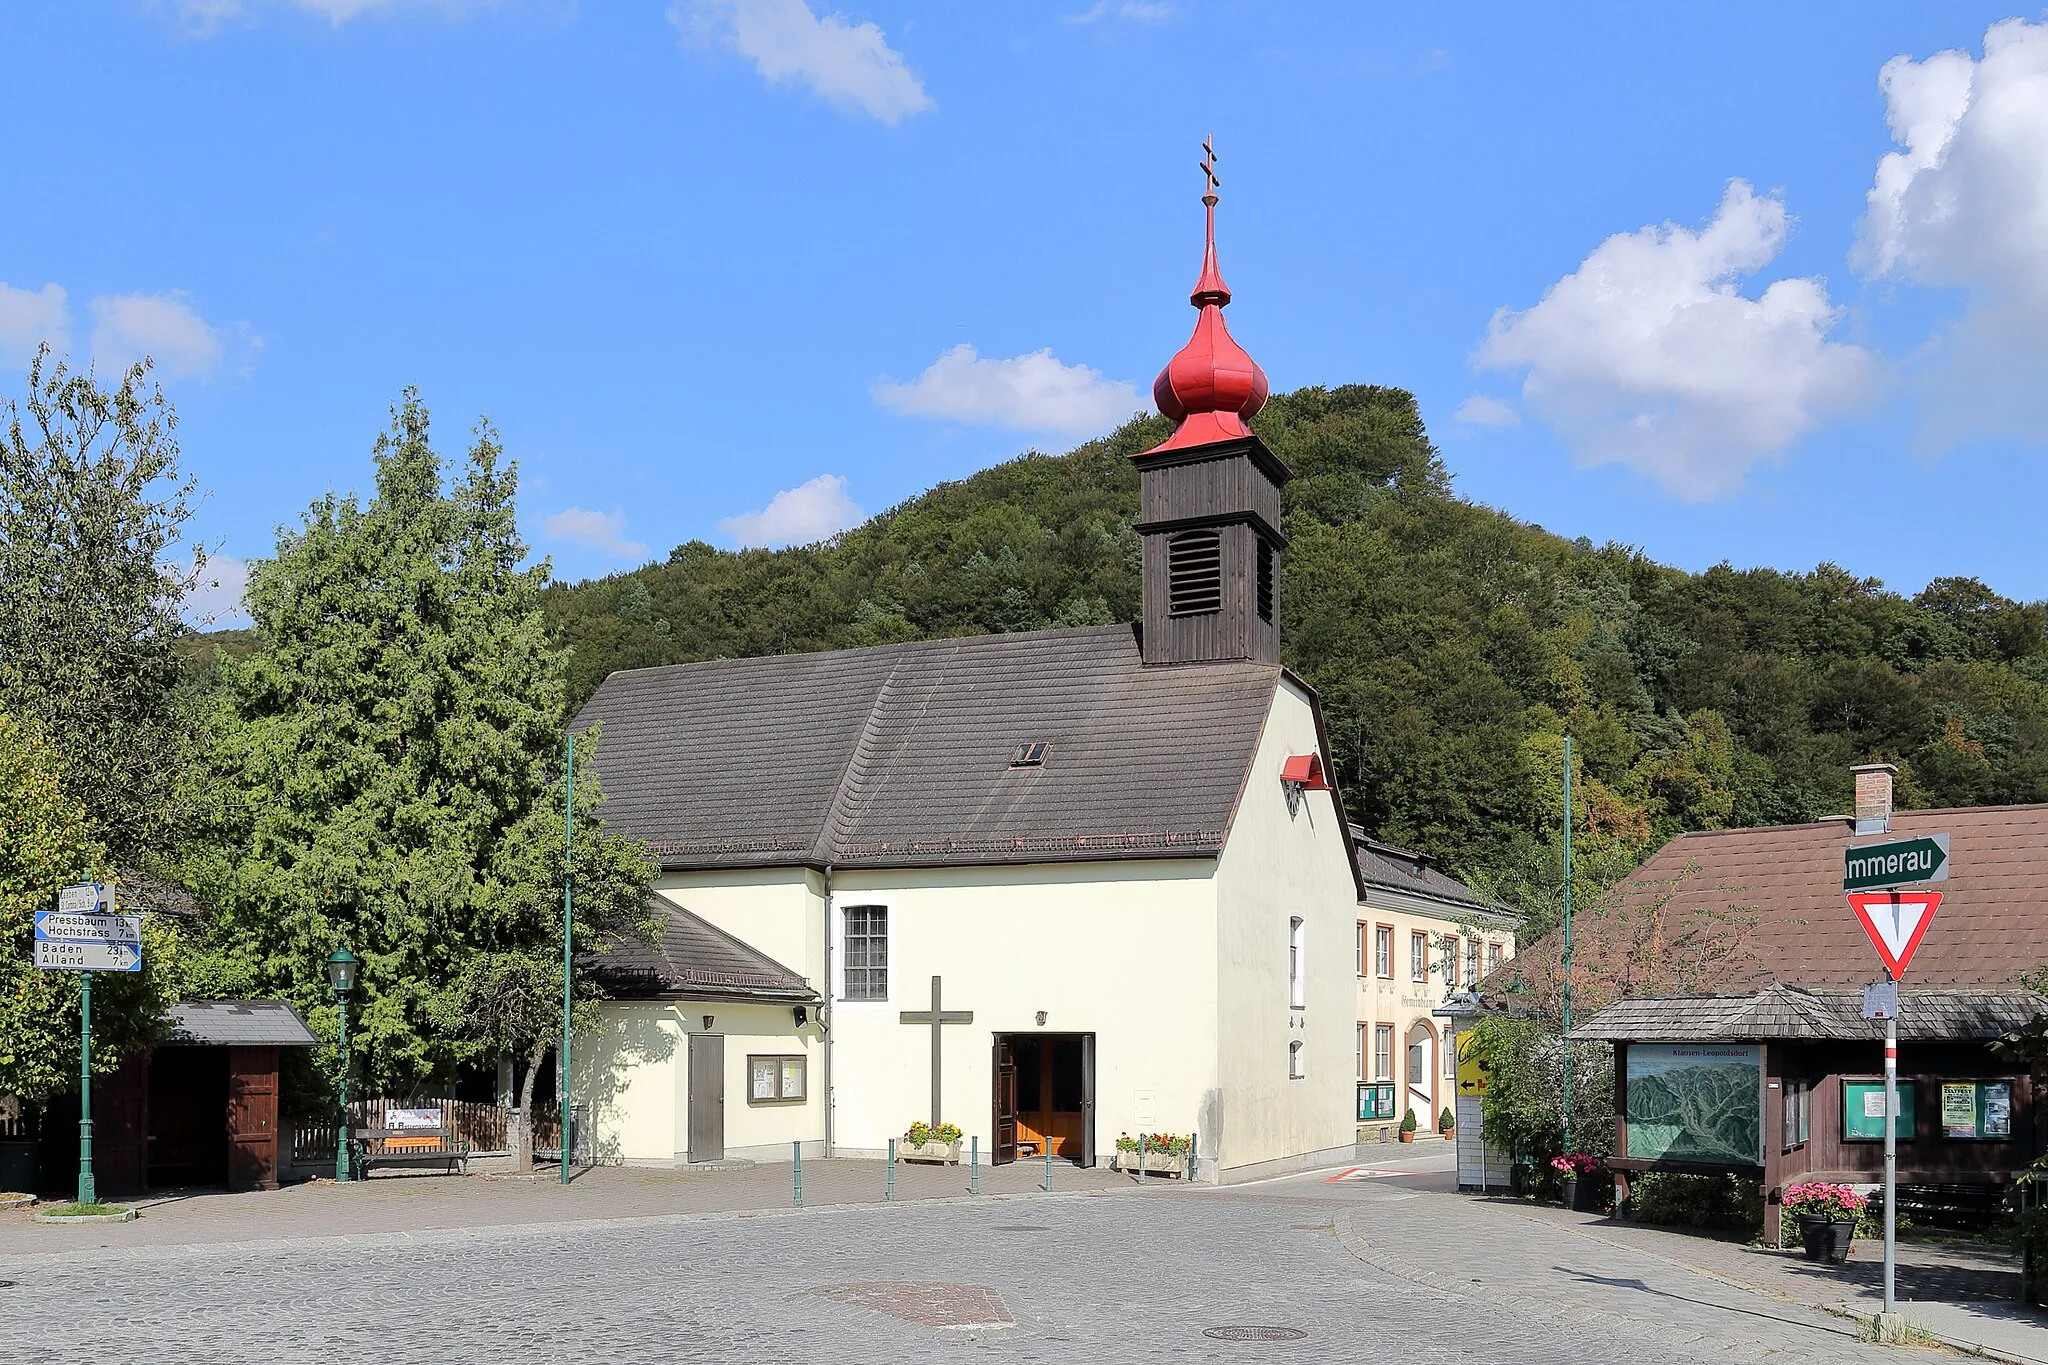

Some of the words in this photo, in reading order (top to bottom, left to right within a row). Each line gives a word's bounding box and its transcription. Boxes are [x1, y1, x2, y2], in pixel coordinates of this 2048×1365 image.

[48, 915, 107, 926] Pressbaum
[48, 926, 110, 938] Hochstrass
[118, 929, 125, 938] 7
[42, 943, 82, 954] Baden
[42, 955, 84, 965] Alland
[112, 957, 119, 966] 7
[1672, 1049, 1749, 1057] Klausen-Leopoldsdorf
